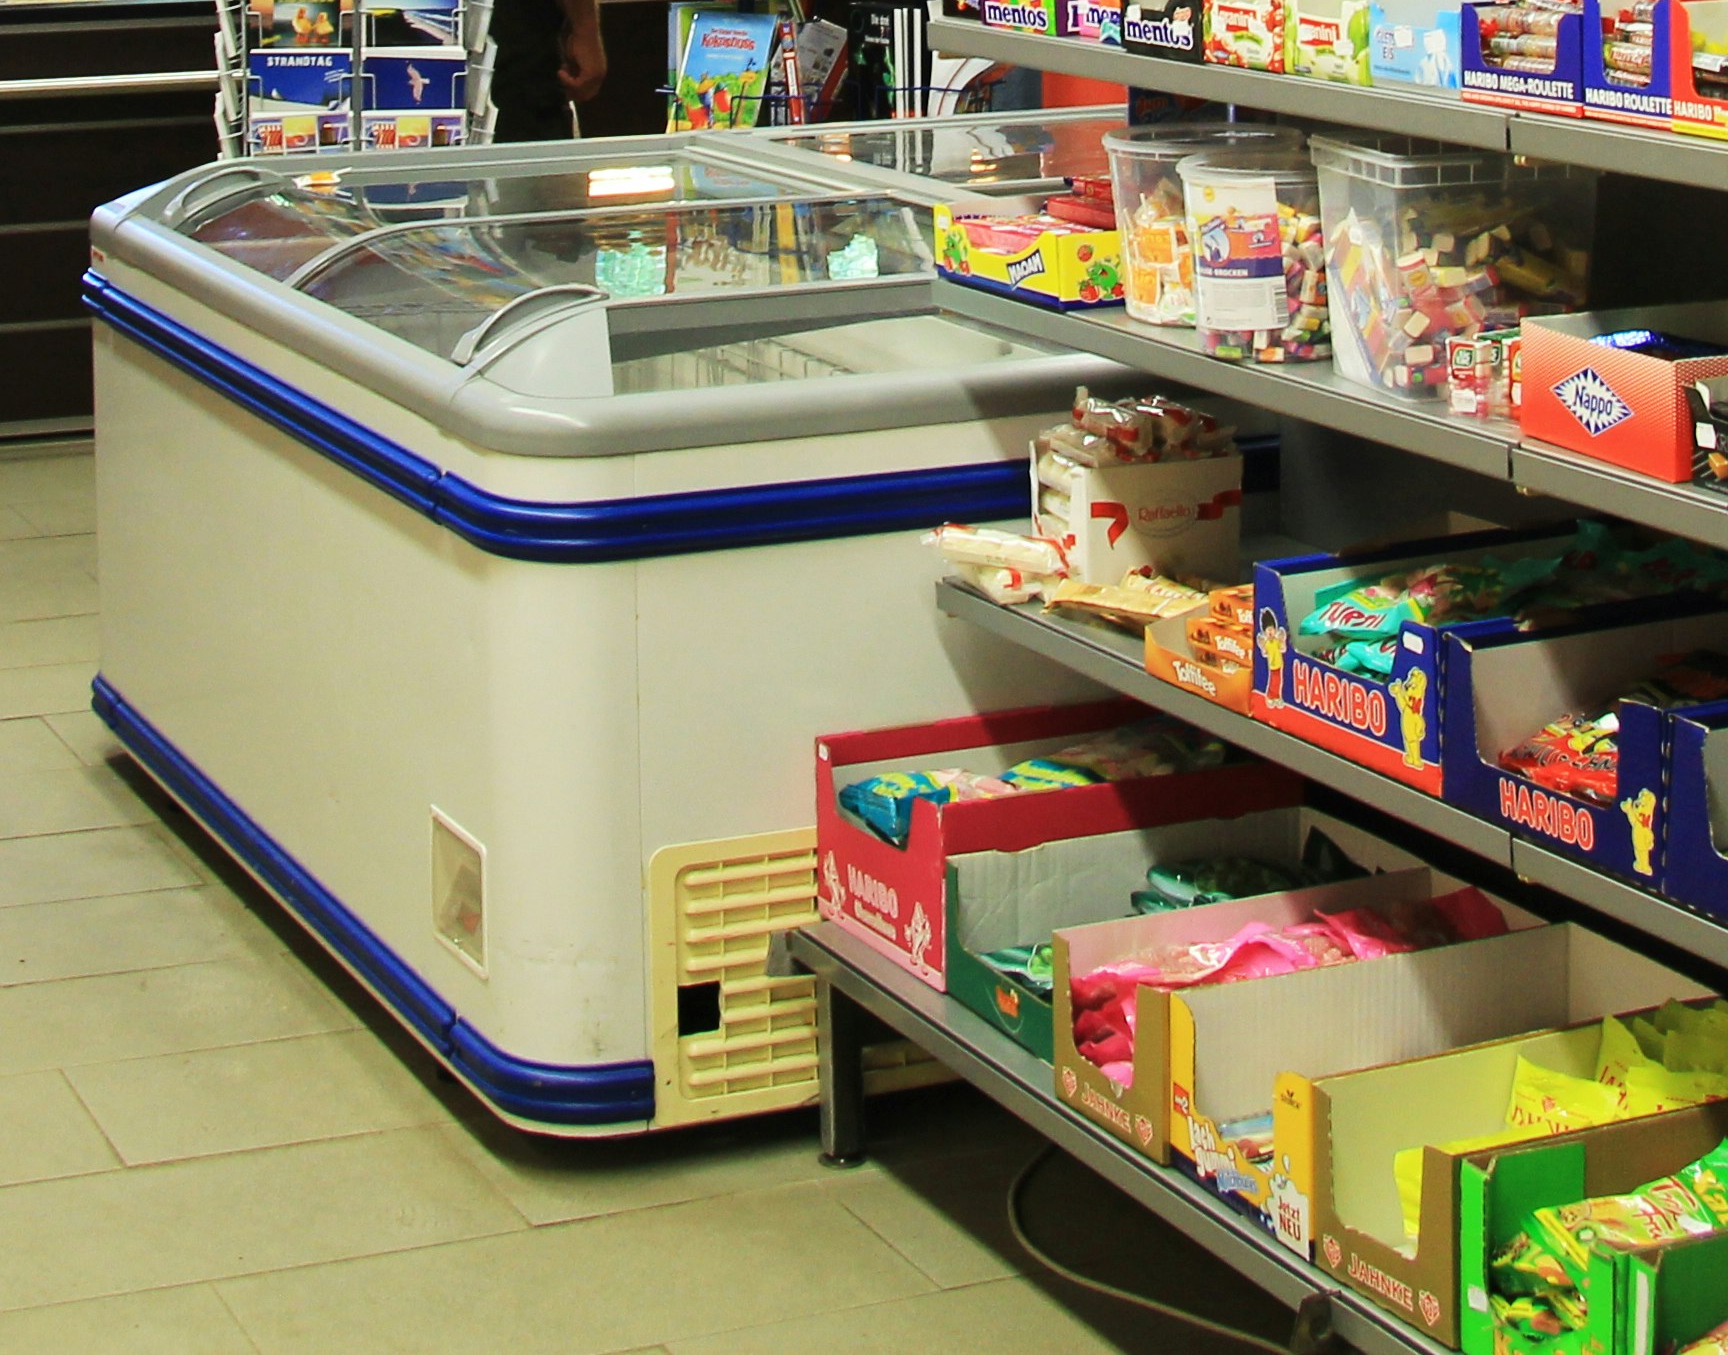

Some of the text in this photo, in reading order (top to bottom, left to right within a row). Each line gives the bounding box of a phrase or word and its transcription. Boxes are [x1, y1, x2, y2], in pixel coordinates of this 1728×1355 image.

[986, 3, 1047, 29] mentos
[1126, 19, 1192, 47] mentos
[266, 56, 333, 67] STRANDTAG
[1463, 70, 1574, 100] HARIBO MEGA-ROULETTE
[1585, 88, 1622, 107] HARIBO
[1624, 91, 1672, 115] ROULETTE
[1673, 100, 1712, 121] HARIBO
[1574, 382, 1614, 420] Nappo
[1172, 660, 1217, 697] Toffifee
[1292, 659, 1387, 737] HARIBO
[1499, 777, 1594, 852] HARIBO
[847, 863, 898, 919] HARIBO
[1082, 1082, 1132, 1134] JAHNKE
[1277, 1195, 1301, 1220] Jetzt
[1278, 1210, 1302, 1242] NEU
[1348, 1252, 1414, 1312] JAHNKE
